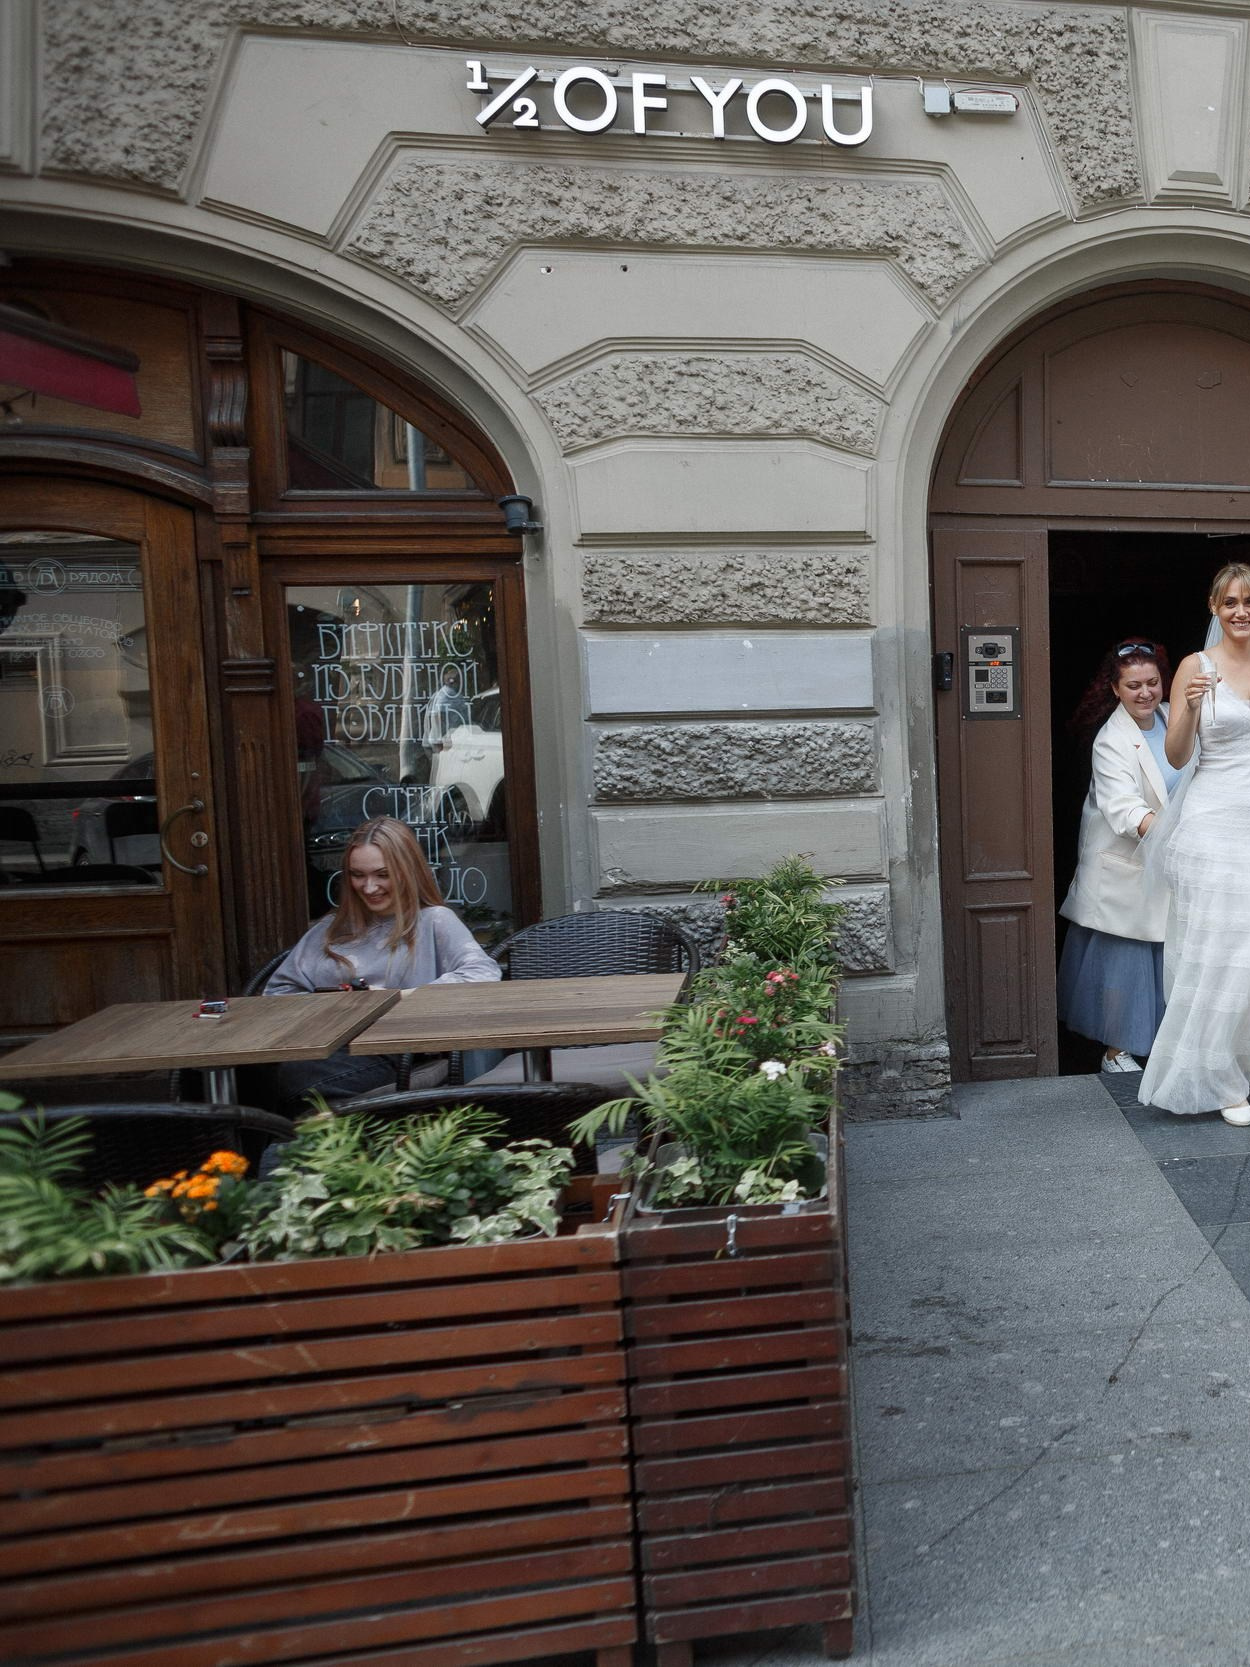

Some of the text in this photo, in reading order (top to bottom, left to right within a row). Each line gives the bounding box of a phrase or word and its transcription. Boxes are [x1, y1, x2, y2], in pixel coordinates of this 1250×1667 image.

[552, 66, 668, 136] OF
[690, 76, 874, 146] YOU
[317, 620, 474, 660] БИФШТЕКС
[311, 663, 351, 701] ИЗ
[362, 784, 462, 825] СТЕЙК
